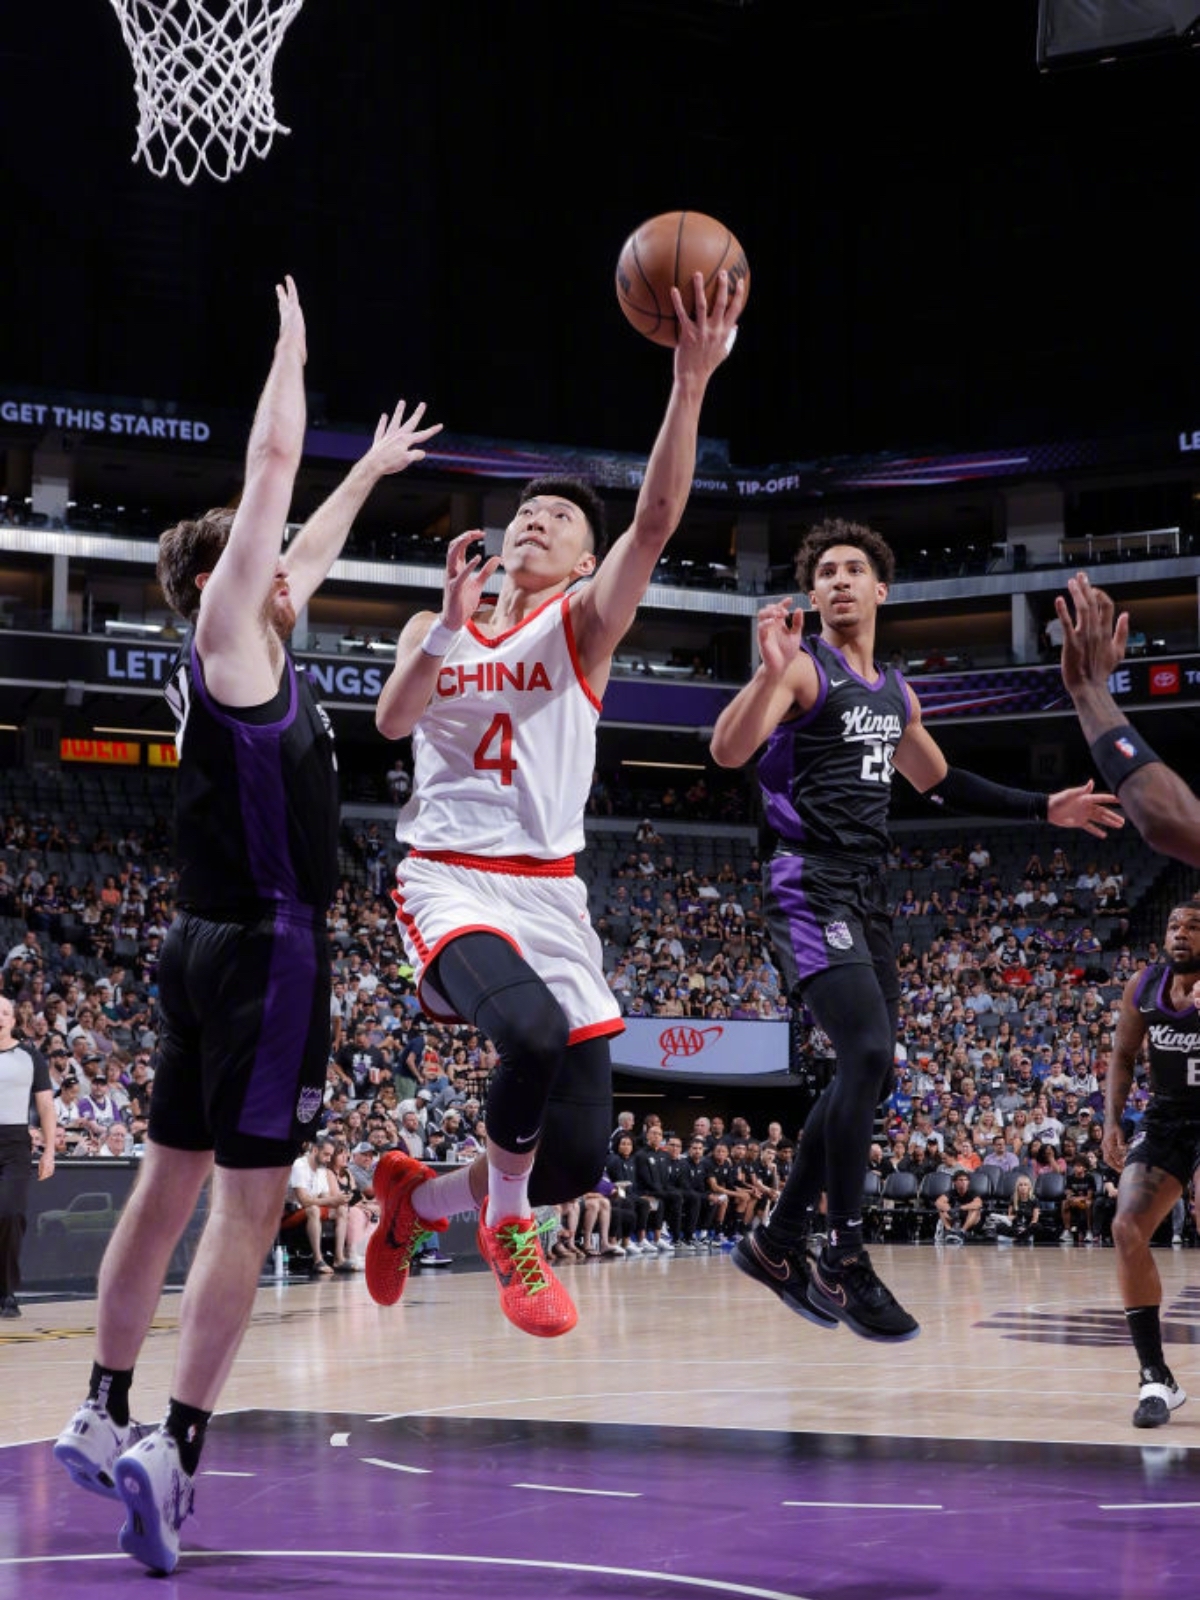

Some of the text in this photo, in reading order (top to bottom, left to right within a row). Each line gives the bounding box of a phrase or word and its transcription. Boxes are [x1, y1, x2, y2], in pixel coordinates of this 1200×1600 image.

[0, 401, 211, 442] GET THIS STARTED
[692, 479, 728, 491] OYOTA
[736, 475, 799, 496] TIP-OFF!
[310, 663, 382, 696] NGS
[436, 661, 553, 697] CHINA
[473, 712, 517, 786] 4
[663, 1027, 702, 1057] AAA
